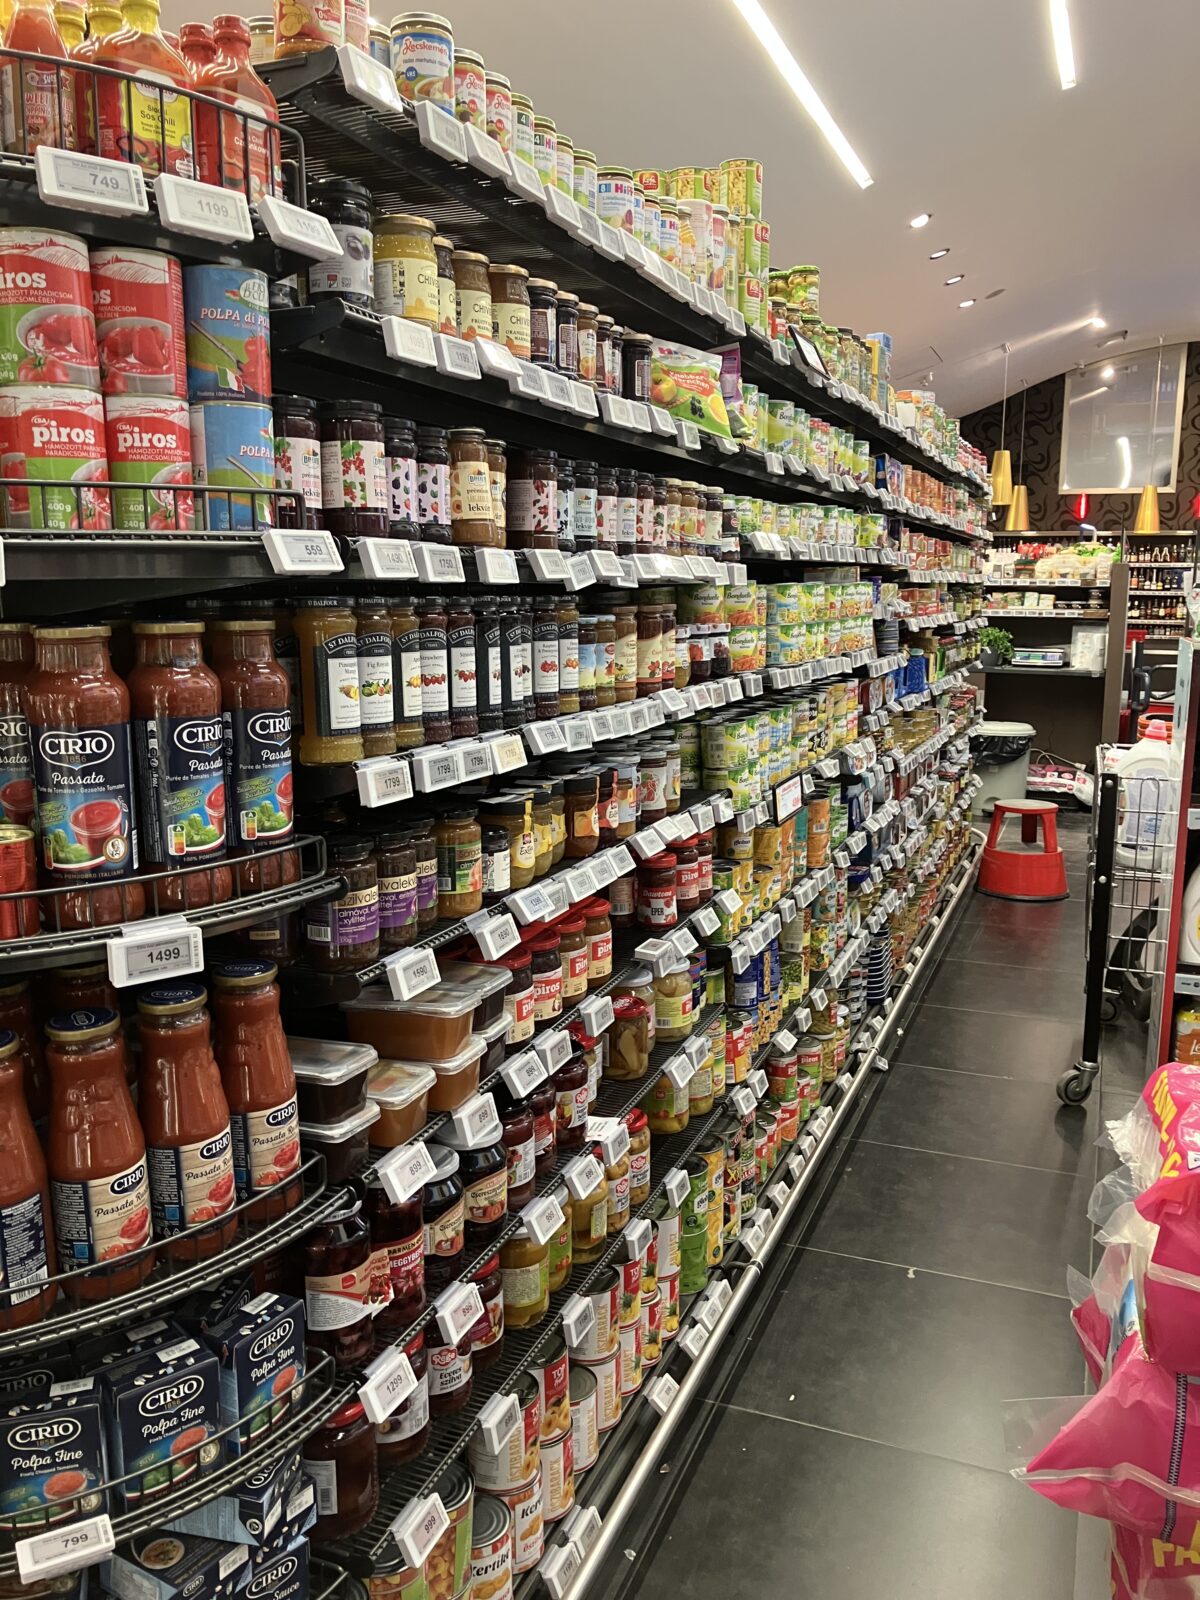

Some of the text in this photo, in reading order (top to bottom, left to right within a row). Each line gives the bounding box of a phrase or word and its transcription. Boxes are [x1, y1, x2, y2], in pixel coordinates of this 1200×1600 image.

[89, 173, 120, 190] 749
[197, 200, 229, 218] 1199
[0, 266, 47, 288] iros
[200, 308, 255, 322] POLPA di
[32, 420, 96, 448] piros
[116, 426, 177, 453] piros
[48, 503, 71, 512] 400 g
[128, 504, 144, 512] 400
[124, 520, 138, 528] 240
[304, 544, 323, 556] 559
[0, 722, 28, 738] RIO
[45, 736, 108, 754] CIRIO
[0, 754, 30, 764] ssata
[64, 755, 88, 764] 1856
[470, 756, 484, 768] 1799
[52, 772, 105, 784] Passata
[436, 764, 452, 776] 1799
[384, 776, 400, 790] 1799
[682, 870, 698, 884] piro
[338, 890, 378, 907] szilvale
[650, 906, 664, 916] EPER
[147, 948, 181, 964] 1499
[598, 942, 612, 956] piro
[575, 961, 588, 974] pir
[534, 980, 561, 997] piros
[268, 1102, 297, 1124] CIRIO
[202, 1133, 230, 1156] CIRIO
[252, 1132, 286, 1146] Passata
[185, 1166, 222, 1181] Passata
[409, 1160, 422, 1176] 899
[113, 1167, 144, 1190] CIRIO
[94, 1199, 134, 1218] Passata
[253, 1322, 291, 1354] CIRIO
[250, 1345, 296, 1381] Polpa Fine
[386, 1374, 404, 1394] 1299
[145, 1380, 198, 1410] CIRIO
[142, 1405, 206, 1438] Polpa Fine
[15, 1422, 74, 1444] CIRIO
[11, 1450, 84, 1470] Polpa Fine
[424, 1515, 437, 1534] 999
[62, 1534, 90, 1548] 799
[252, 1560, 292, 1591] CIRIO
[274, 1580, 300, 1600] Sauce
